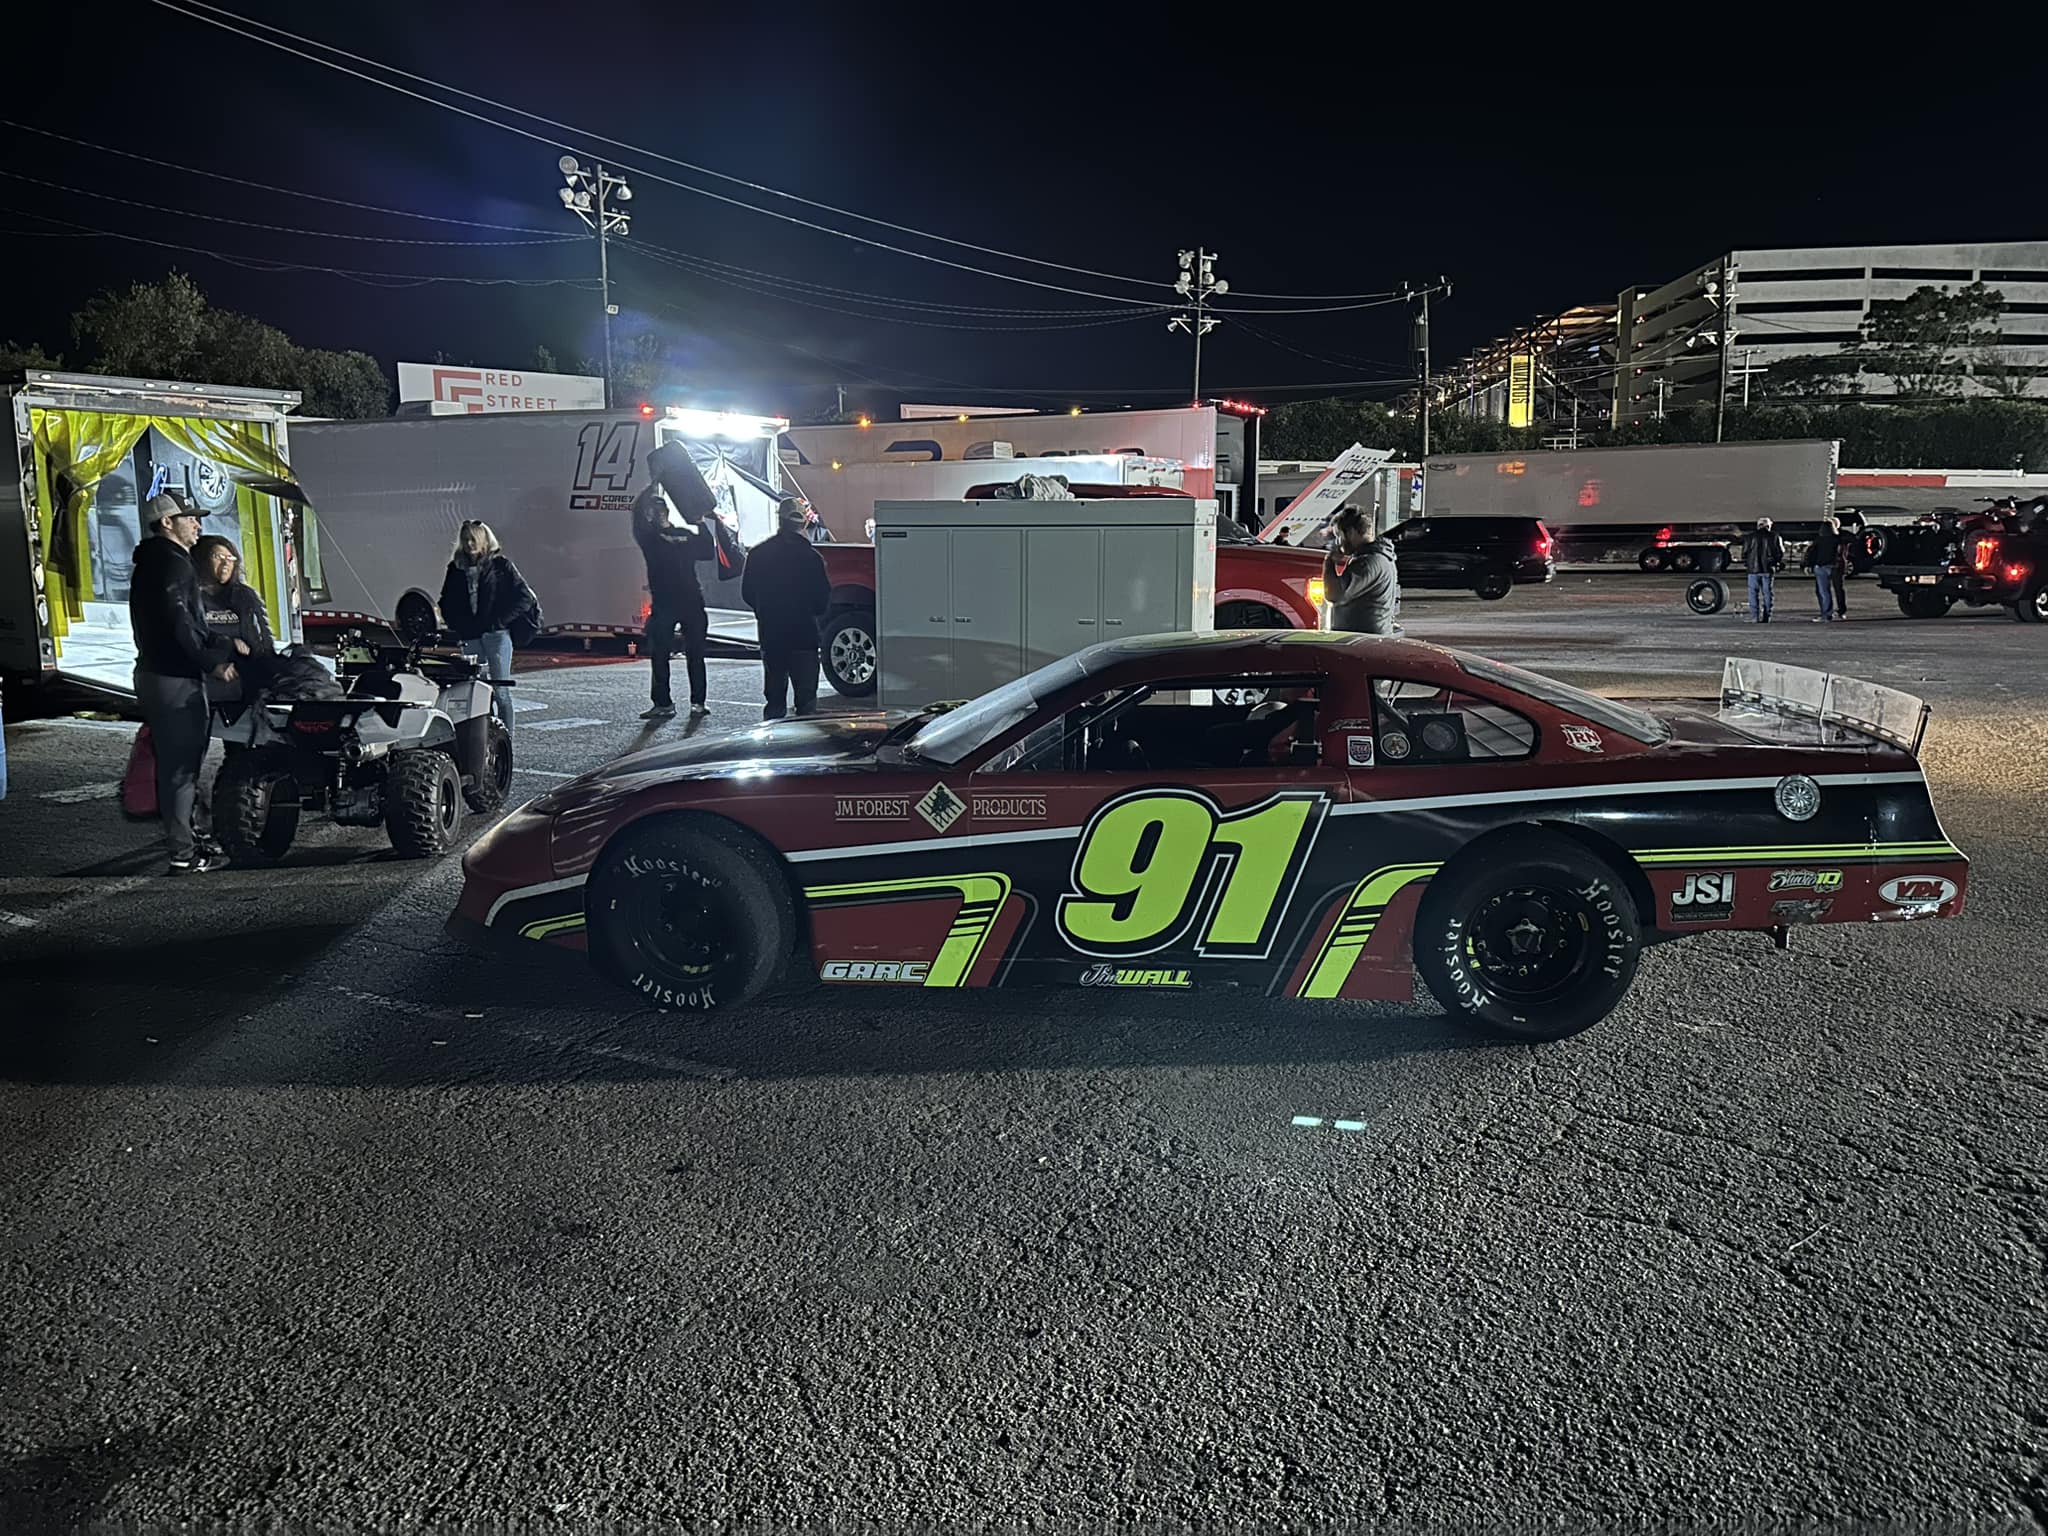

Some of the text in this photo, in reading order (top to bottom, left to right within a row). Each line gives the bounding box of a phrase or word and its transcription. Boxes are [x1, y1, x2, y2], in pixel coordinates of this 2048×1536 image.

[485, 373, 523, 386] RED
[486, 394, 557, 410] STREET
[573, 421, 640, 490] 14
[835, 799, 1047, 817] JM FOREST PRODUCTS
[1056, 789, 1331, 958] 91
[1672, 873, 1733, 906] JSI
[821, 960, 930, 982] GARC
[1117, 969, 1192, 986] WALL
